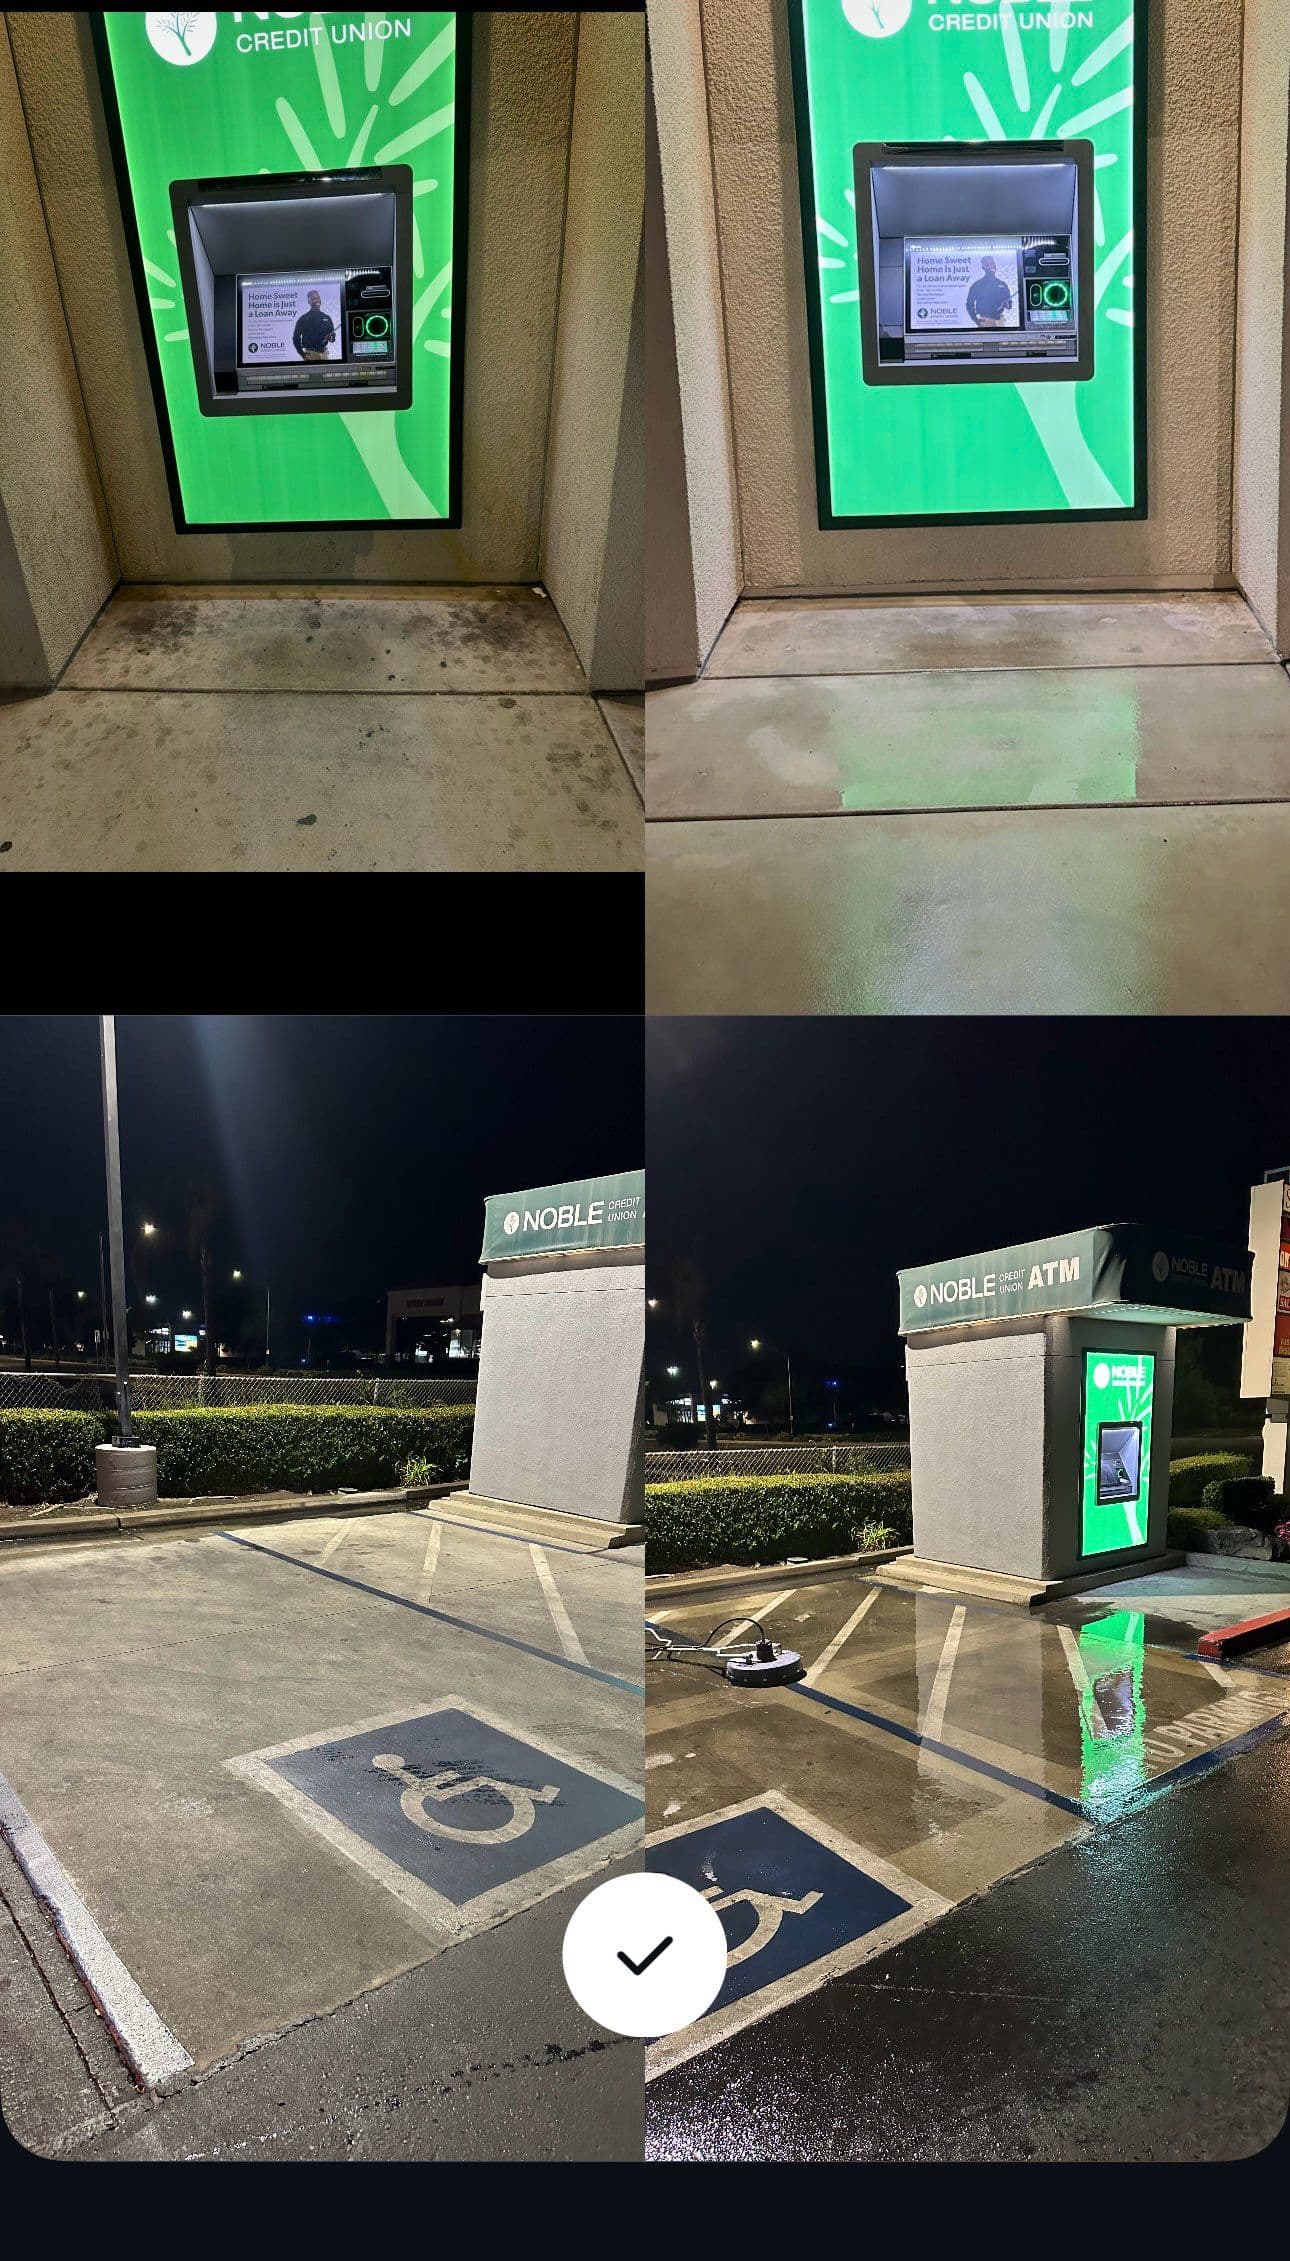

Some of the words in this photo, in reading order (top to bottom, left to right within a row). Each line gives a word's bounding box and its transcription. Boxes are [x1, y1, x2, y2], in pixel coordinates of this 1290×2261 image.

[928, 13, 1013, 31] CREDIT
[1019, 11, 1093, 30] UNION
[236, 27, 324, 53] CREDIT
[331, 18, 411, 44] UNION
[944, 256, 971, 264] Sweet
[917, 265, 943, 273] Home
[944, 265, 952, 273] is
[953, 265, 970, 274] Just
[946, 274, 971, 283] Away
[248, 293, 272, 301] Home
[273, 292, 298, 300] Sweet
[248, 301, 272, 309] Home
[273, 300, 280, 308] is
[281, 300, 296, 309] Just
[254, 310, 274, 318] Loan
[275, 309, 298, 318] Away
[260, 341, 286, 349] NOBLE
[523, 1201, 605, 1232] NOBLE
[608, 1196, 641, 1210] CREDIT
[607, 1209, 637, 1222] UNION
[930, 1273, 996, 1305] NOBLE
[999, 1268, 1026, 1283] CREDIT
[1027, 1256, 1081, 1290] ATM
[1171, 1257, 1209, 1277] NOBLE
[1210, 1265, 1247, 1296] ATM
[999, 1281, 1024, 1294] UNION
